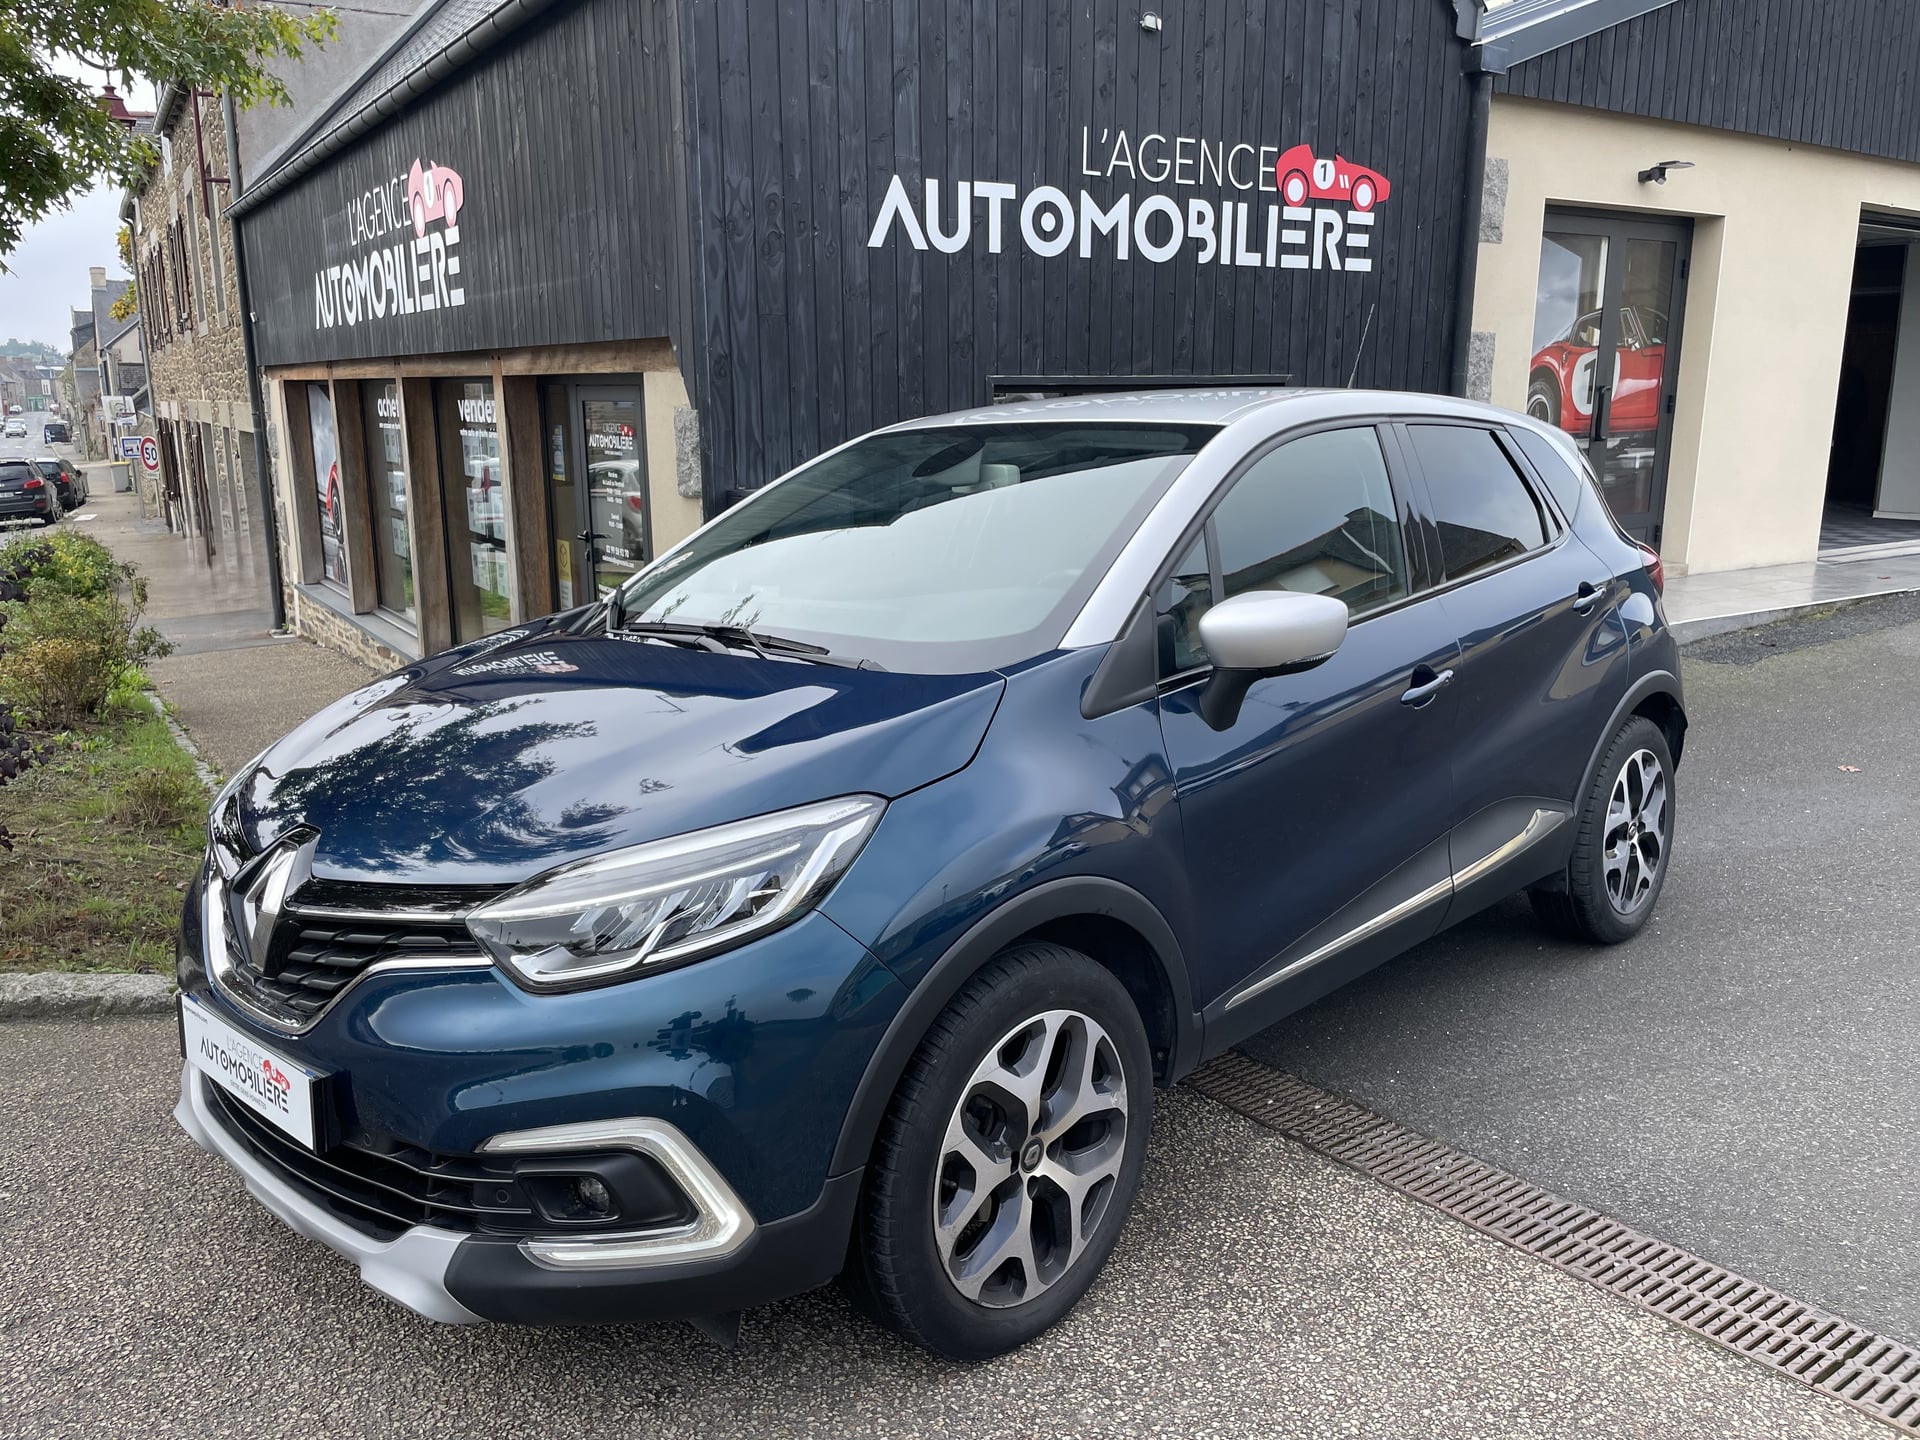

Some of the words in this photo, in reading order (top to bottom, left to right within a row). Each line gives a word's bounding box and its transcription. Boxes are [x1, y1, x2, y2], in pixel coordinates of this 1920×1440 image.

[1081, 126, 1279, 191] L'AGENCE
[1320, 162, 1328, 182] 1
[347, 174, 412, 246] L'AGENCE
[377, 393, 400, 417] achet
[145, 447, 158, 461] 50
[226, 1034, 265, 1073] L'AGENCE
